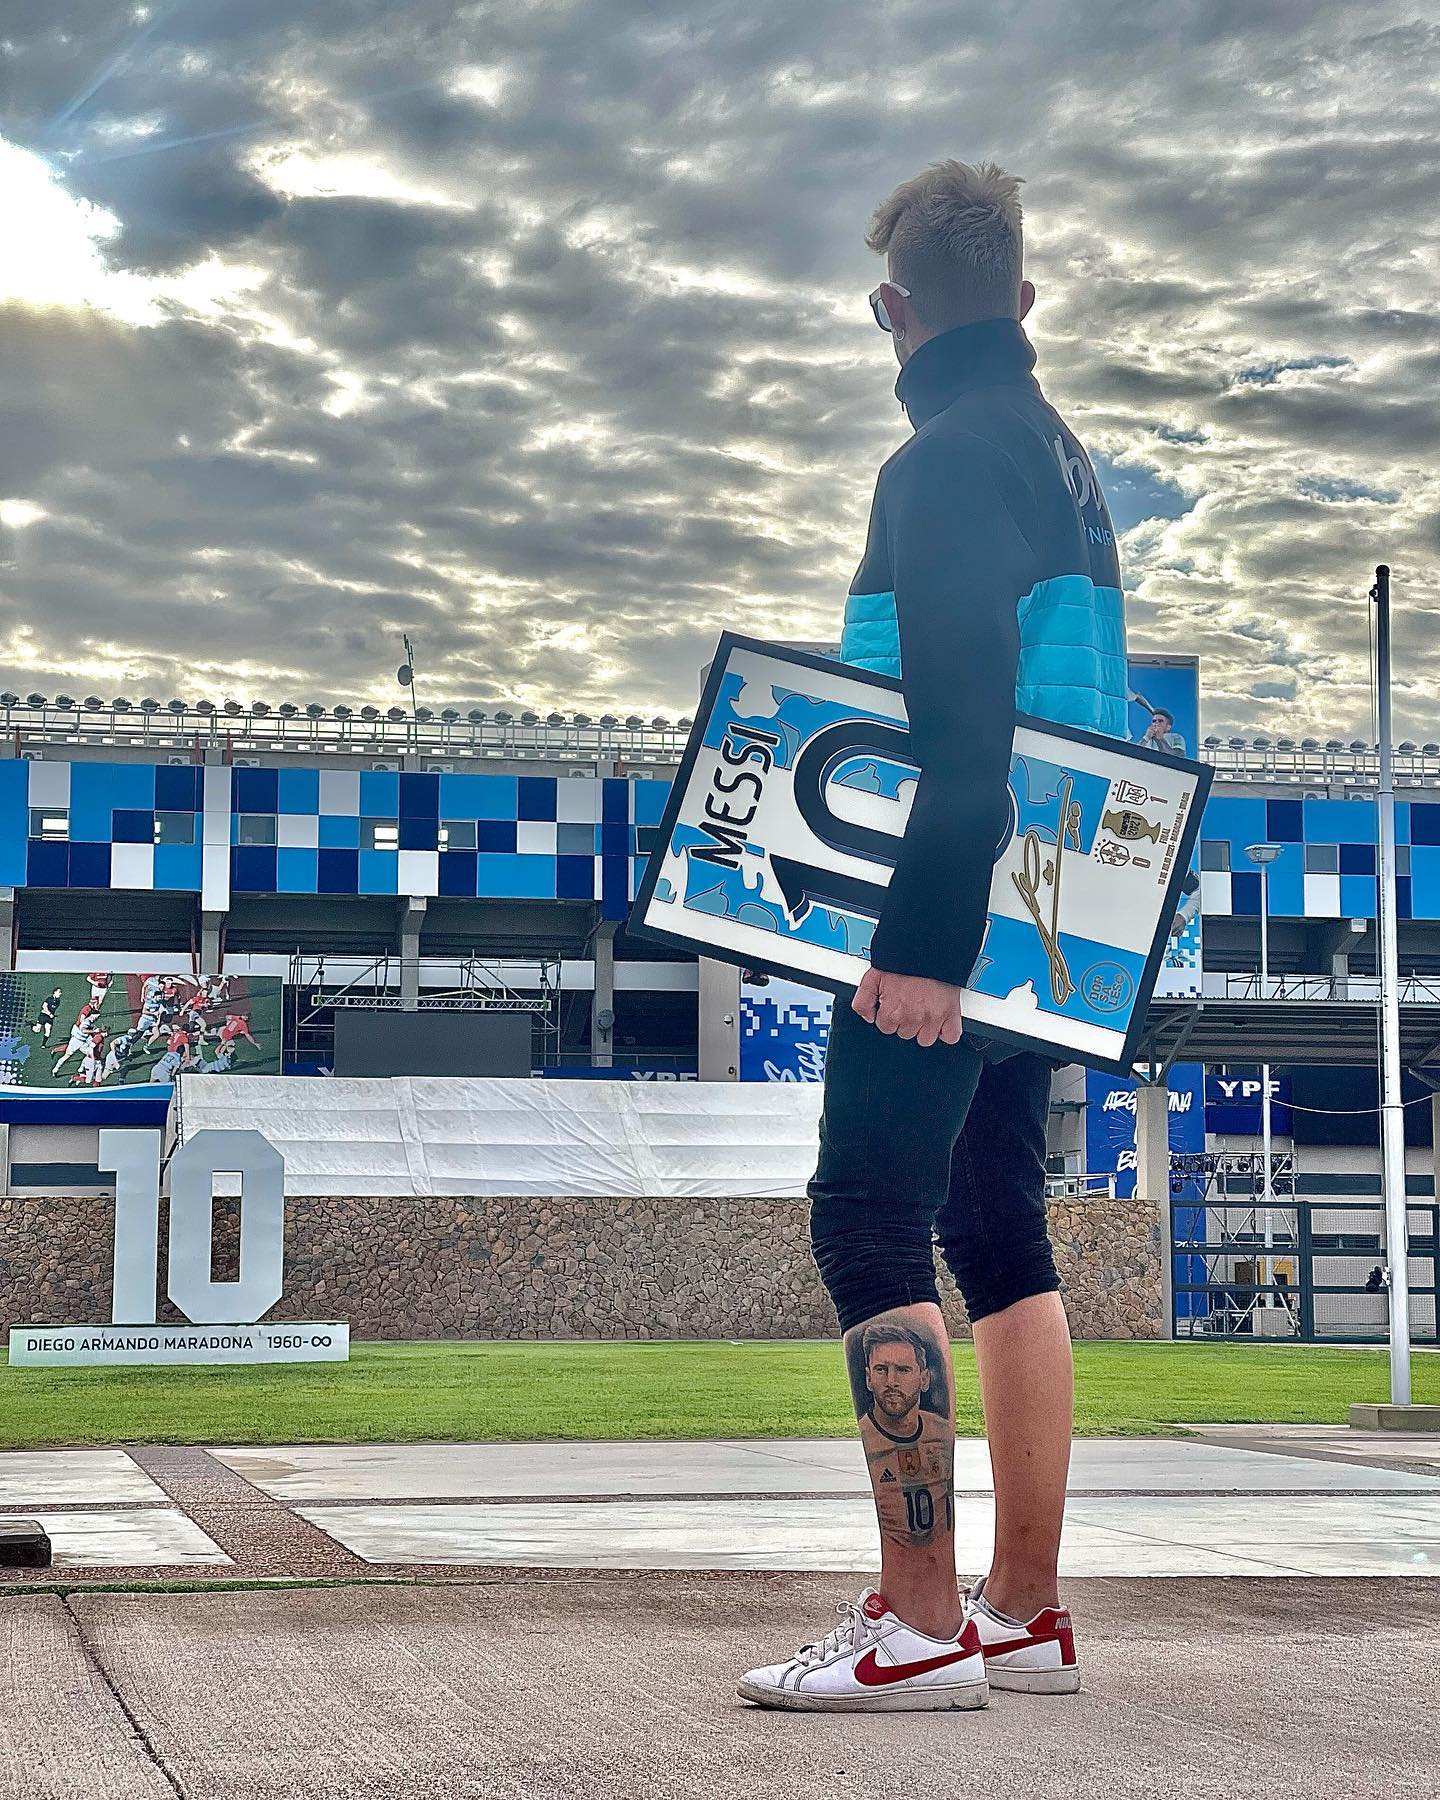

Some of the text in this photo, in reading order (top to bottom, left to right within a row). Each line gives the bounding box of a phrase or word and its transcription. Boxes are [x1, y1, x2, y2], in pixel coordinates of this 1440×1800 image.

[690, 724, 779, 869] MESSI
[1128, 816, 1141, 836] 2021
[1159, 828, 1171, 844] FINAL
[1166, 845, 1175, 858] 2021
[1090, 975, 1103, 1001] DOR
[1100, 987, 1111, 1003] SA
[1217, 1080, 1280, 1097] YPF
[1103, 1090, 1192, 1115] ARGTINA
[98, 1129, 285, 1324] 10
[27, 1338, 75, 1351] DIEGO
[79, 1337, 159, 1350] ARMANDO
[164, 1336, 253, 1350] MARADONA
[903, 1488, 934, 1532] 10
